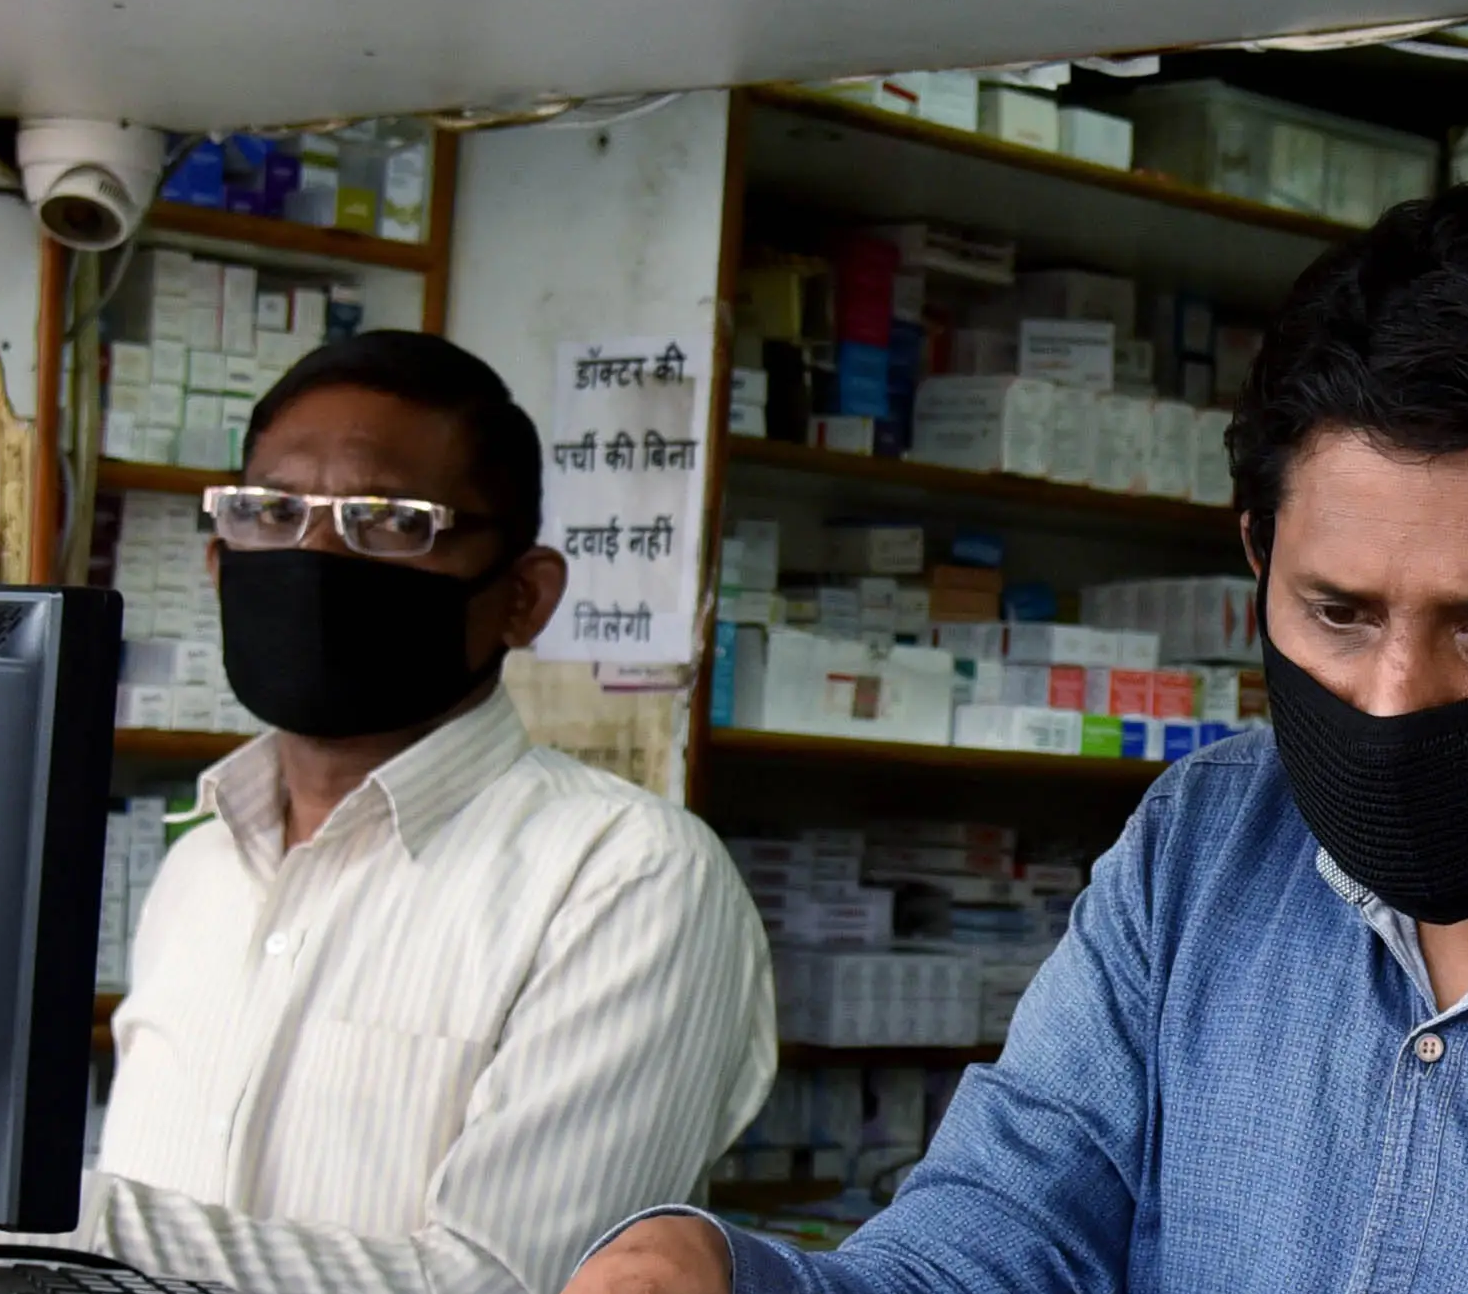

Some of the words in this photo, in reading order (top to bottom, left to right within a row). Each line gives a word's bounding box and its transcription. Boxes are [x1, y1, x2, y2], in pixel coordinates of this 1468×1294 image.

[575, 347, 647, 391] डॉक्टर
[654, 342, 686, 385] की
[605, 431, 636, 471] की
[644, 430, 699, 471] बिना
[565, 515, 620, 563] दवाई
[629, 515, 674, 560] नहीं
[573, 601, 651, 642] मिलेगी
